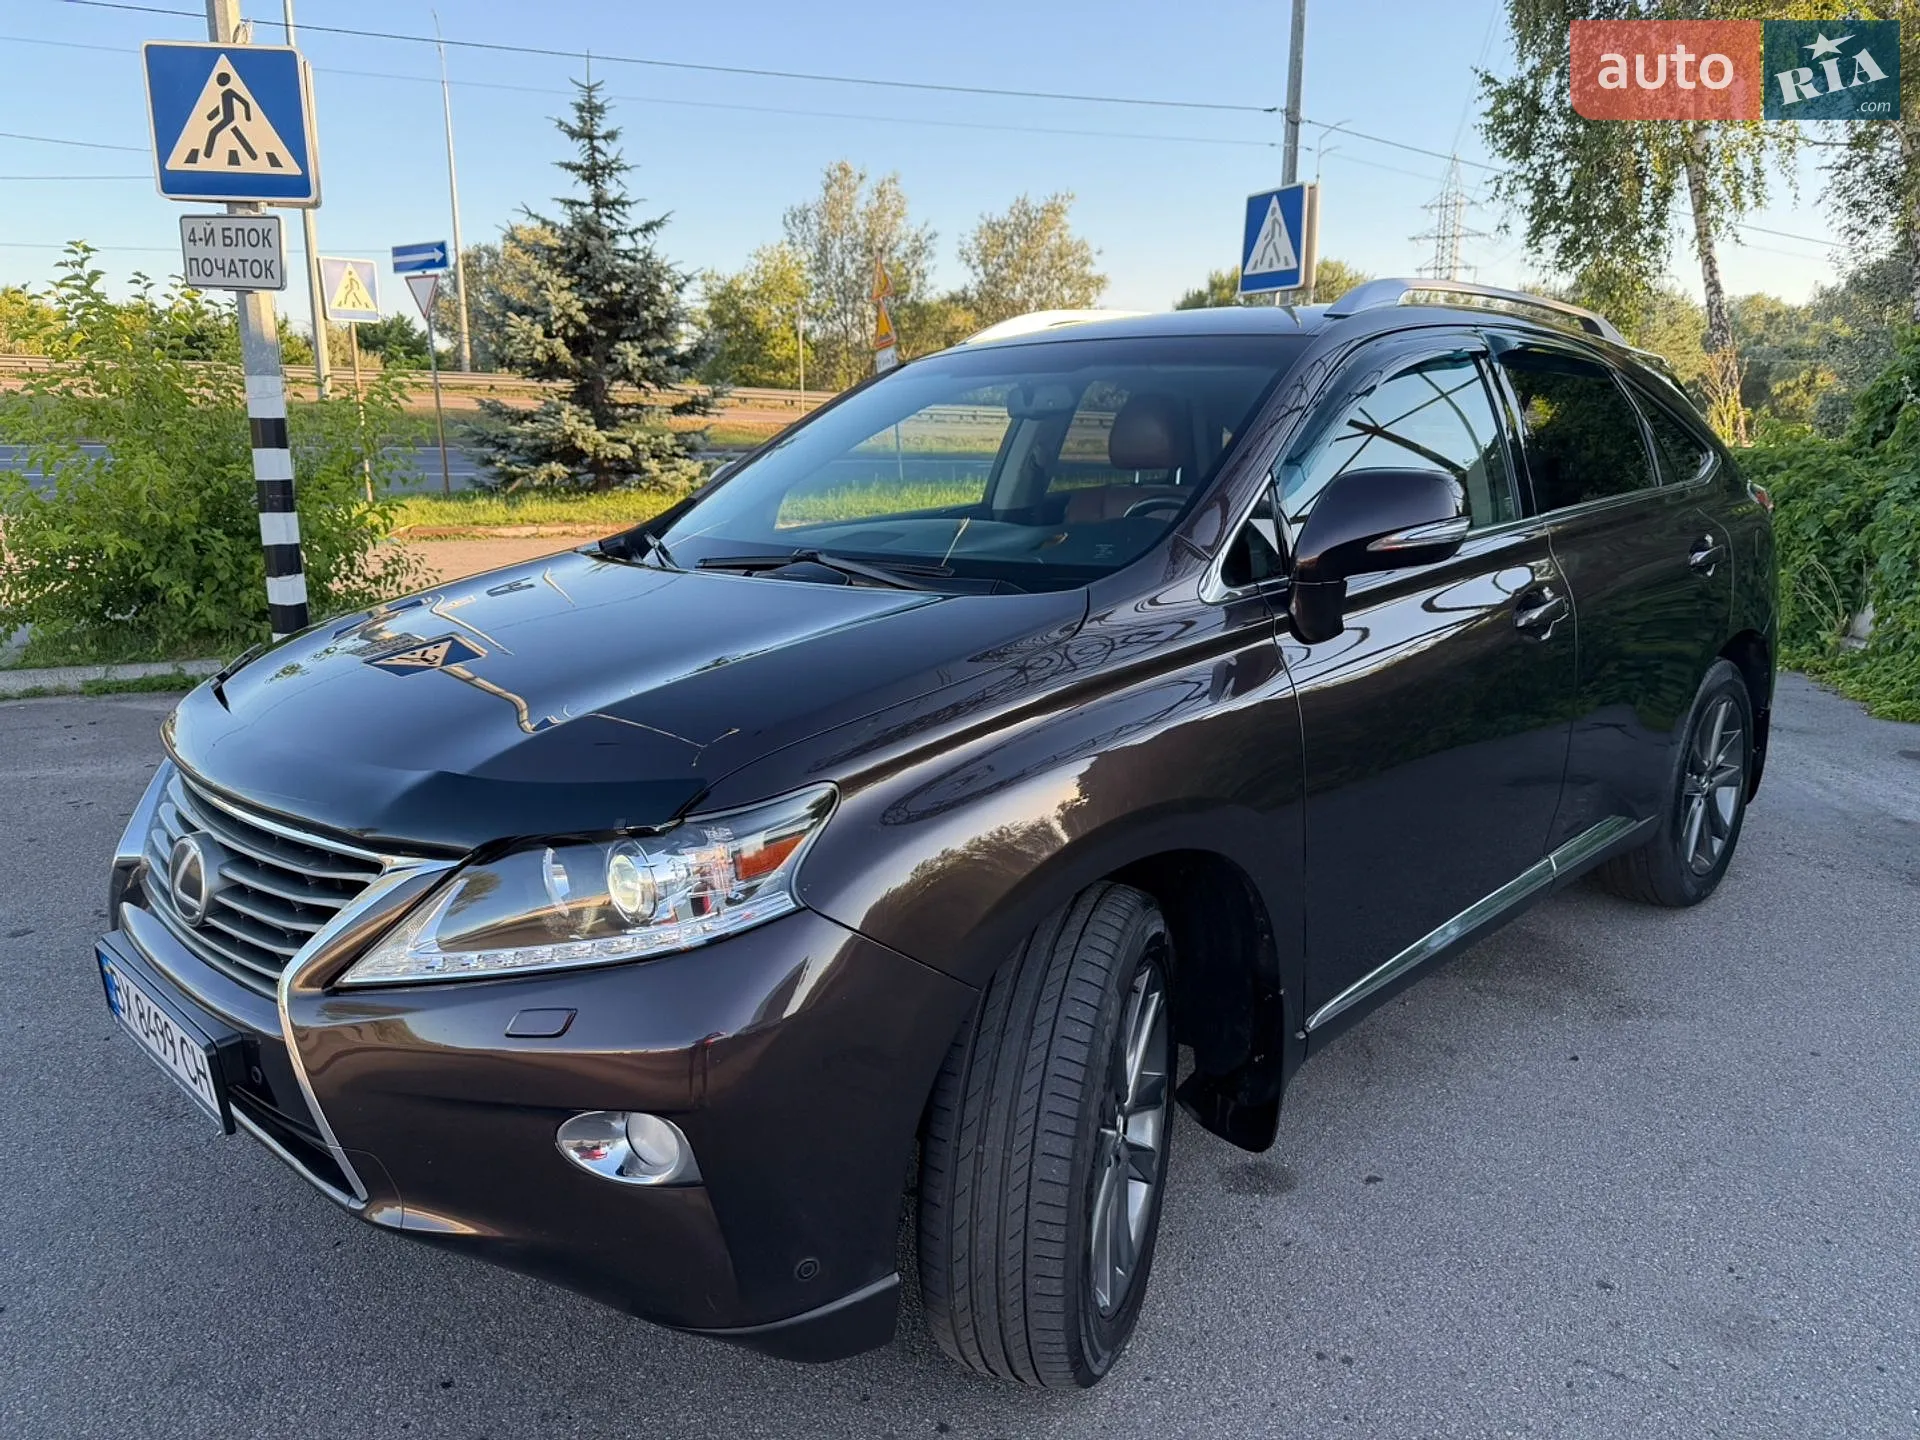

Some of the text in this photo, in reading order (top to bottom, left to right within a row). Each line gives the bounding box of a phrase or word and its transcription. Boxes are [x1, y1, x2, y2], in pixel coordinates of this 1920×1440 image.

[188, 220, 272, 248] 4-Й БЛОК
[188, 257, 275, 280] ПОЧАТОК
[134, 993, 178, 1066] 8499
[180, 1036, 215, 1103] CH
